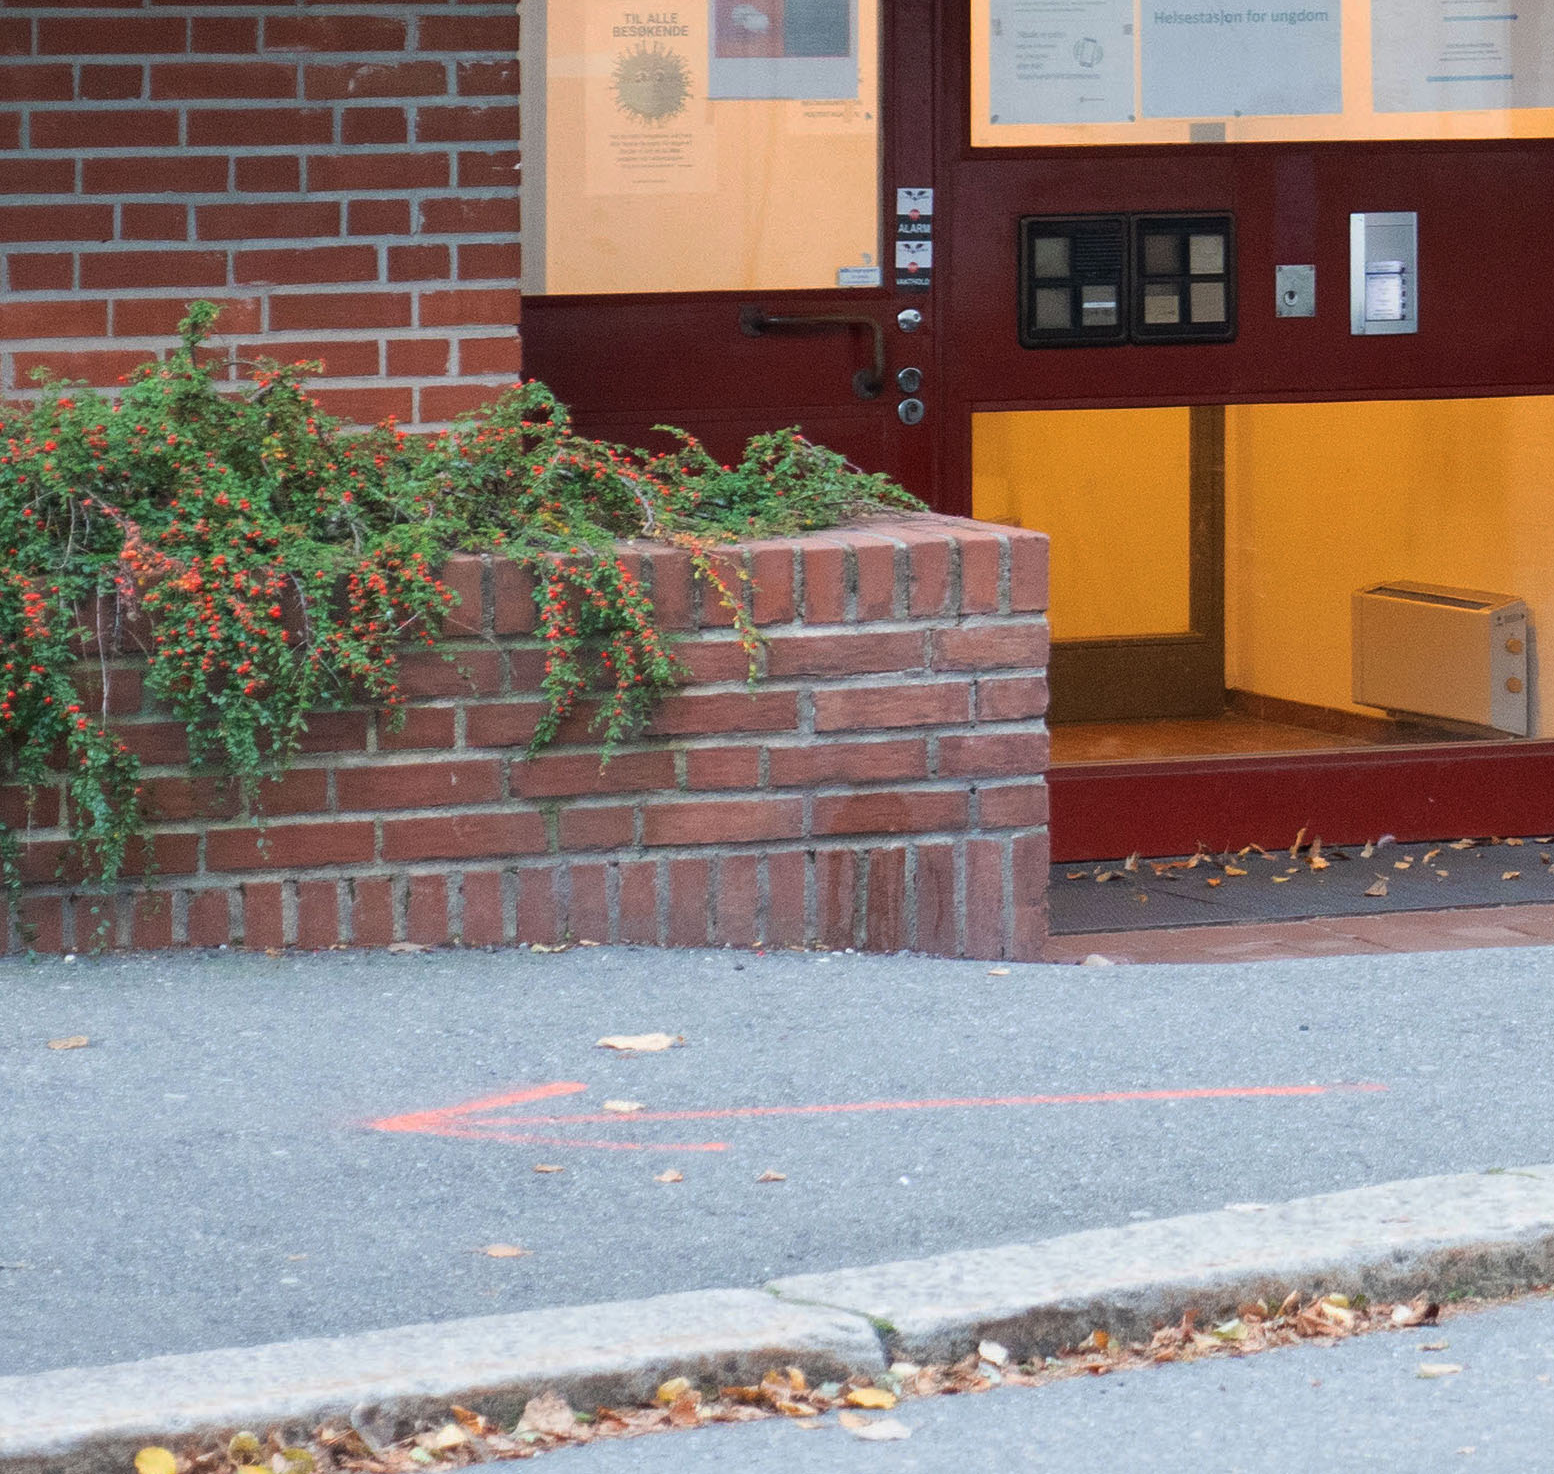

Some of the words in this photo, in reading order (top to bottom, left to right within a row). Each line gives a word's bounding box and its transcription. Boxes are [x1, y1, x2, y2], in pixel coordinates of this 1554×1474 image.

[624, 13, 642, 24] TIL
[647, 12, 677, 24] ALLE
[1154, 10, 1242, 26] Helsestasjon
[1247, 9, 1267, 22] for
[1271, 9, 1329, 25] ungdom
[612, 25, 689, 37] BESØKENDE
[897, 223, 932, 234] ALARM
